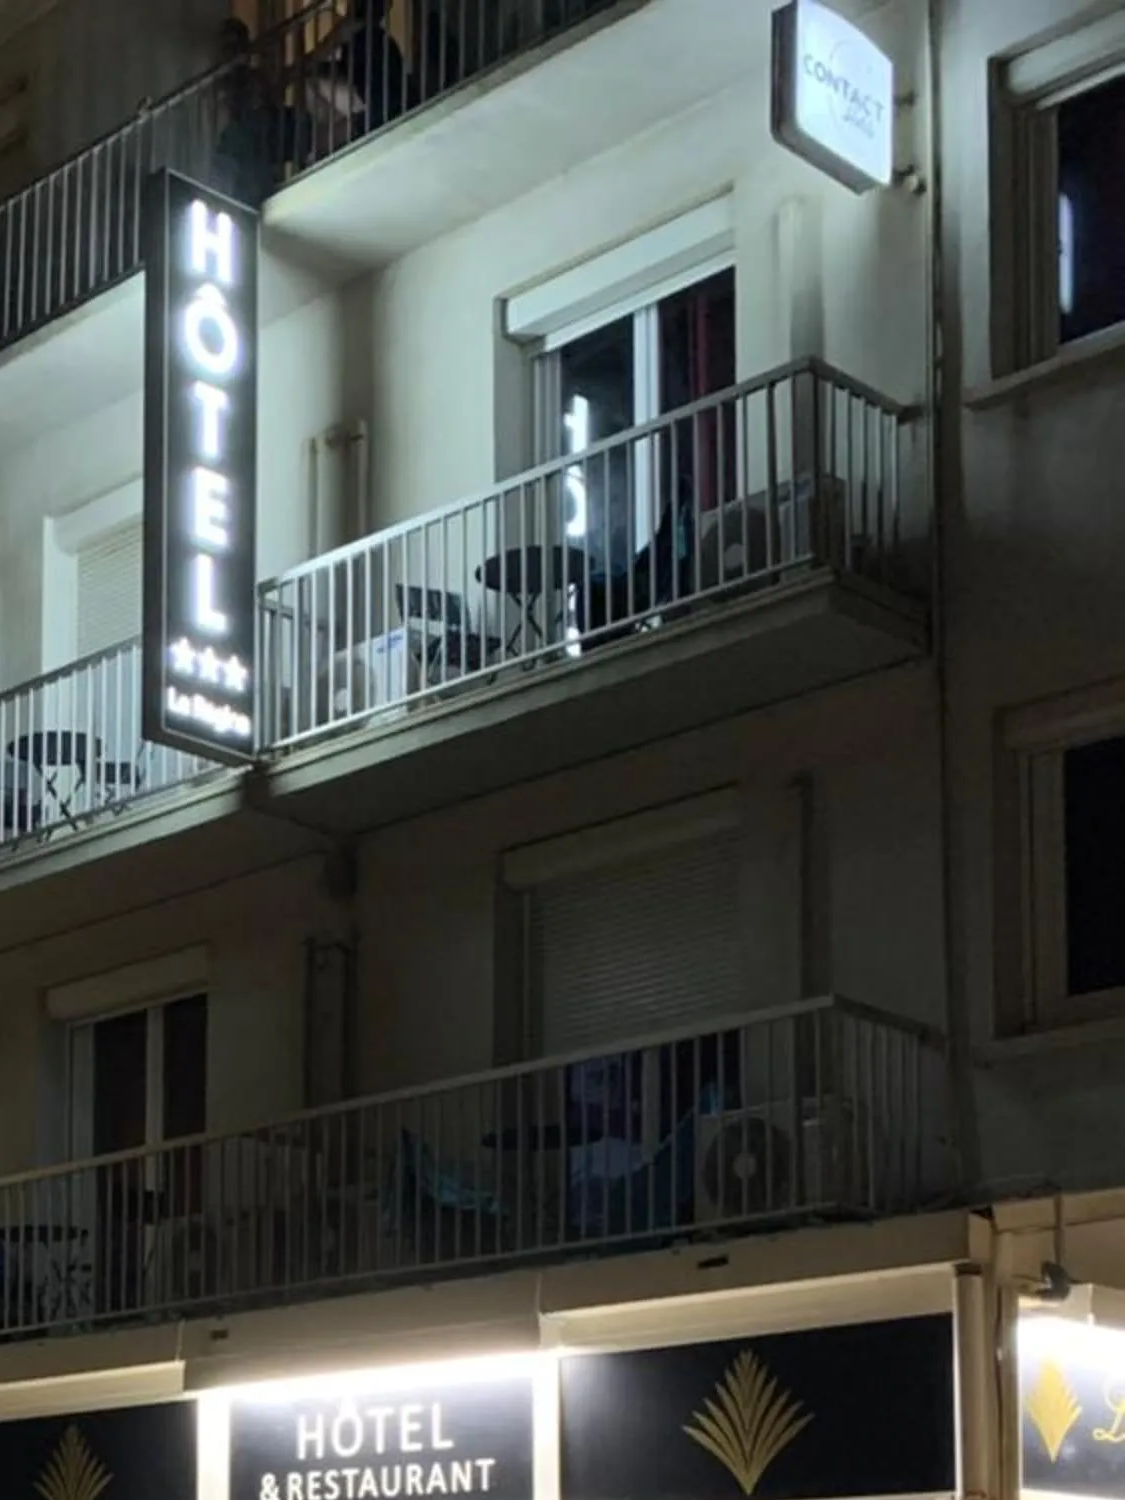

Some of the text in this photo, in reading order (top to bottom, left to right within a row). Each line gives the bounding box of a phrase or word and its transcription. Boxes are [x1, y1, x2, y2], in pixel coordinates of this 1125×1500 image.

[802, 52, 885, 123] CONTACT
[184, 198, 239, 634] HÔTEL
[295, 1398, 456, 1461] HÔTEL
